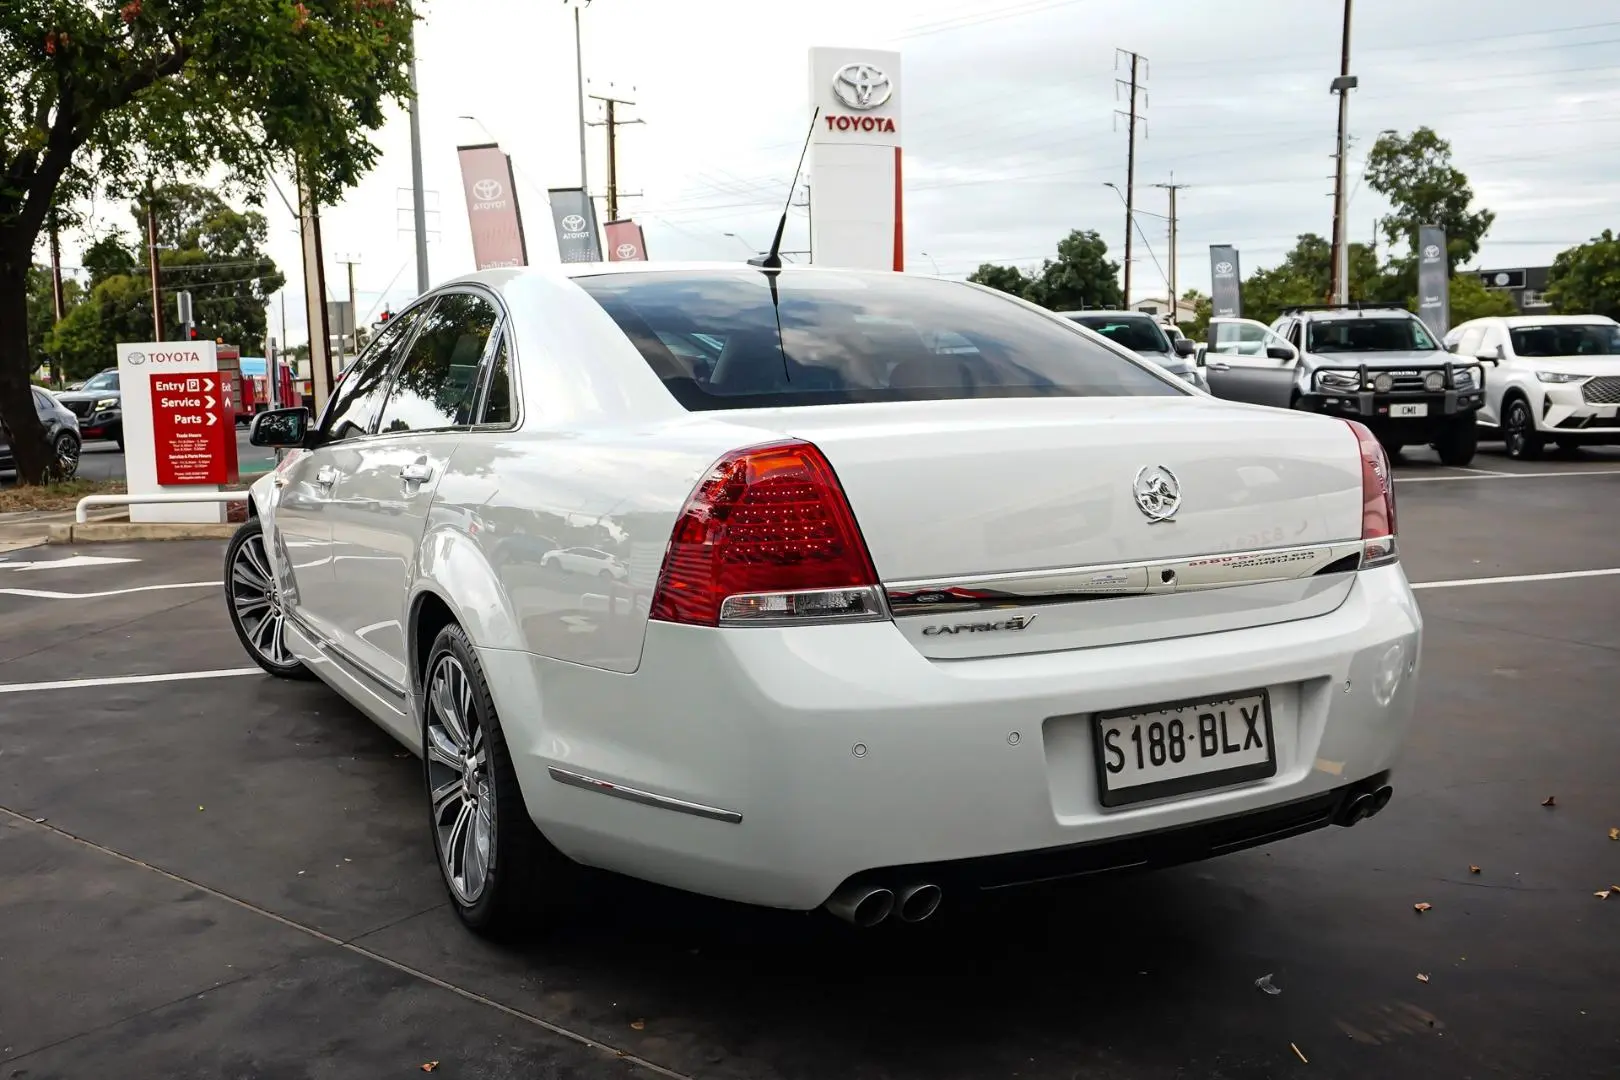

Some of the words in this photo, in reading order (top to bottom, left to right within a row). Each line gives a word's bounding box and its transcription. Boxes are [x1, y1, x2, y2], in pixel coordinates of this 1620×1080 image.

[825, 115, 896, 133] TOYOTA
[148, 352, 200, 363] TOYOTA
[155, 381, 185, 392] Entry
[161, 397, 201, 408] Service
[174, 414, 202, 425] Parts
